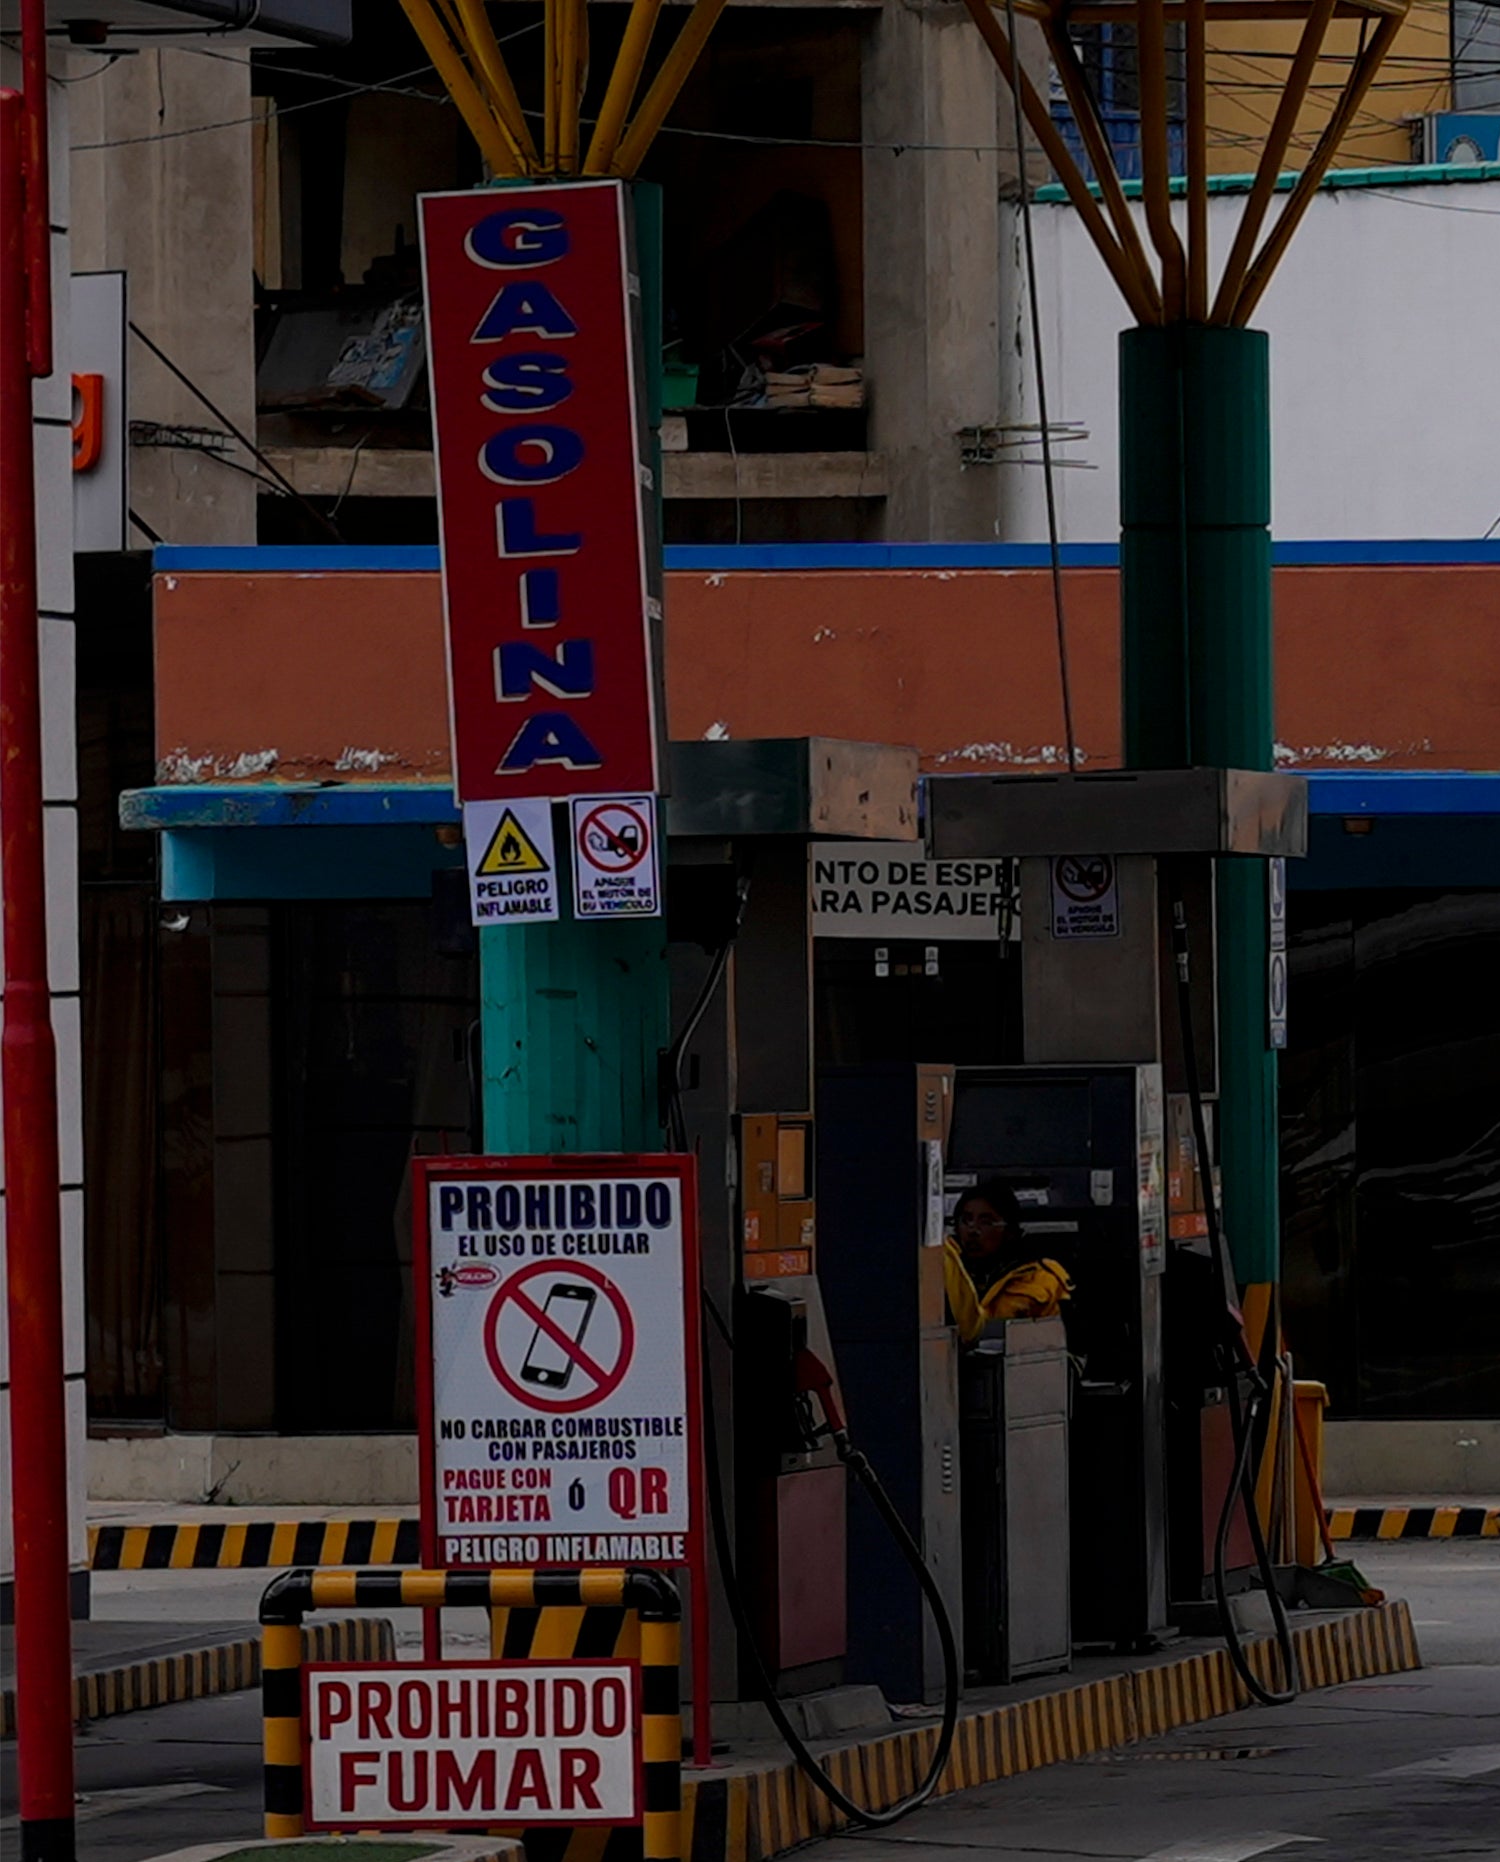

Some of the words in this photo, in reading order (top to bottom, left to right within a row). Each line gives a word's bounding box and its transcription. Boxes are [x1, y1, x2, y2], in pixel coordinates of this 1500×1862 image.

[464, 207, 603, 775] GASOLINA
[889, 862, 926, 886] DE
[477, 878, 548, 897] PELIGRO
[476, 898, 553, 917] INFLAMABLE
[439, 1181, 672, 1231] PROHIBIDO
[458, 1236, 477, 1257] EL
[485, 1235, 525, 1257] USO
[532, 1234, 556, 1256] DE
[562, 1233, 650, 1254] CELULAR
[441, 1419, 465, 1440] NO
[471, 1418, 546, 1440] CARGAR
[552, 1416, 684, 1438] COMBUSTIBLE
[488, 1441, 526, 1461] CON
[532, 1439, 637, 1461] PASAJEROS
[444, 1468, 505, 1490] PAGUE
[511, 1467, 552, 1488] CON
[608, 1467, 669, 1520] QR
[443, 1494, 552, 1523] TARJETA
[444, 1535, 541, 1564] PELIGRO
[546, 1534, 686, 1563] INFLAMABLE
[318, 1677, 627, 1741] PROHIBIDO
[340, 1748, 603, 1813] FUMAR
